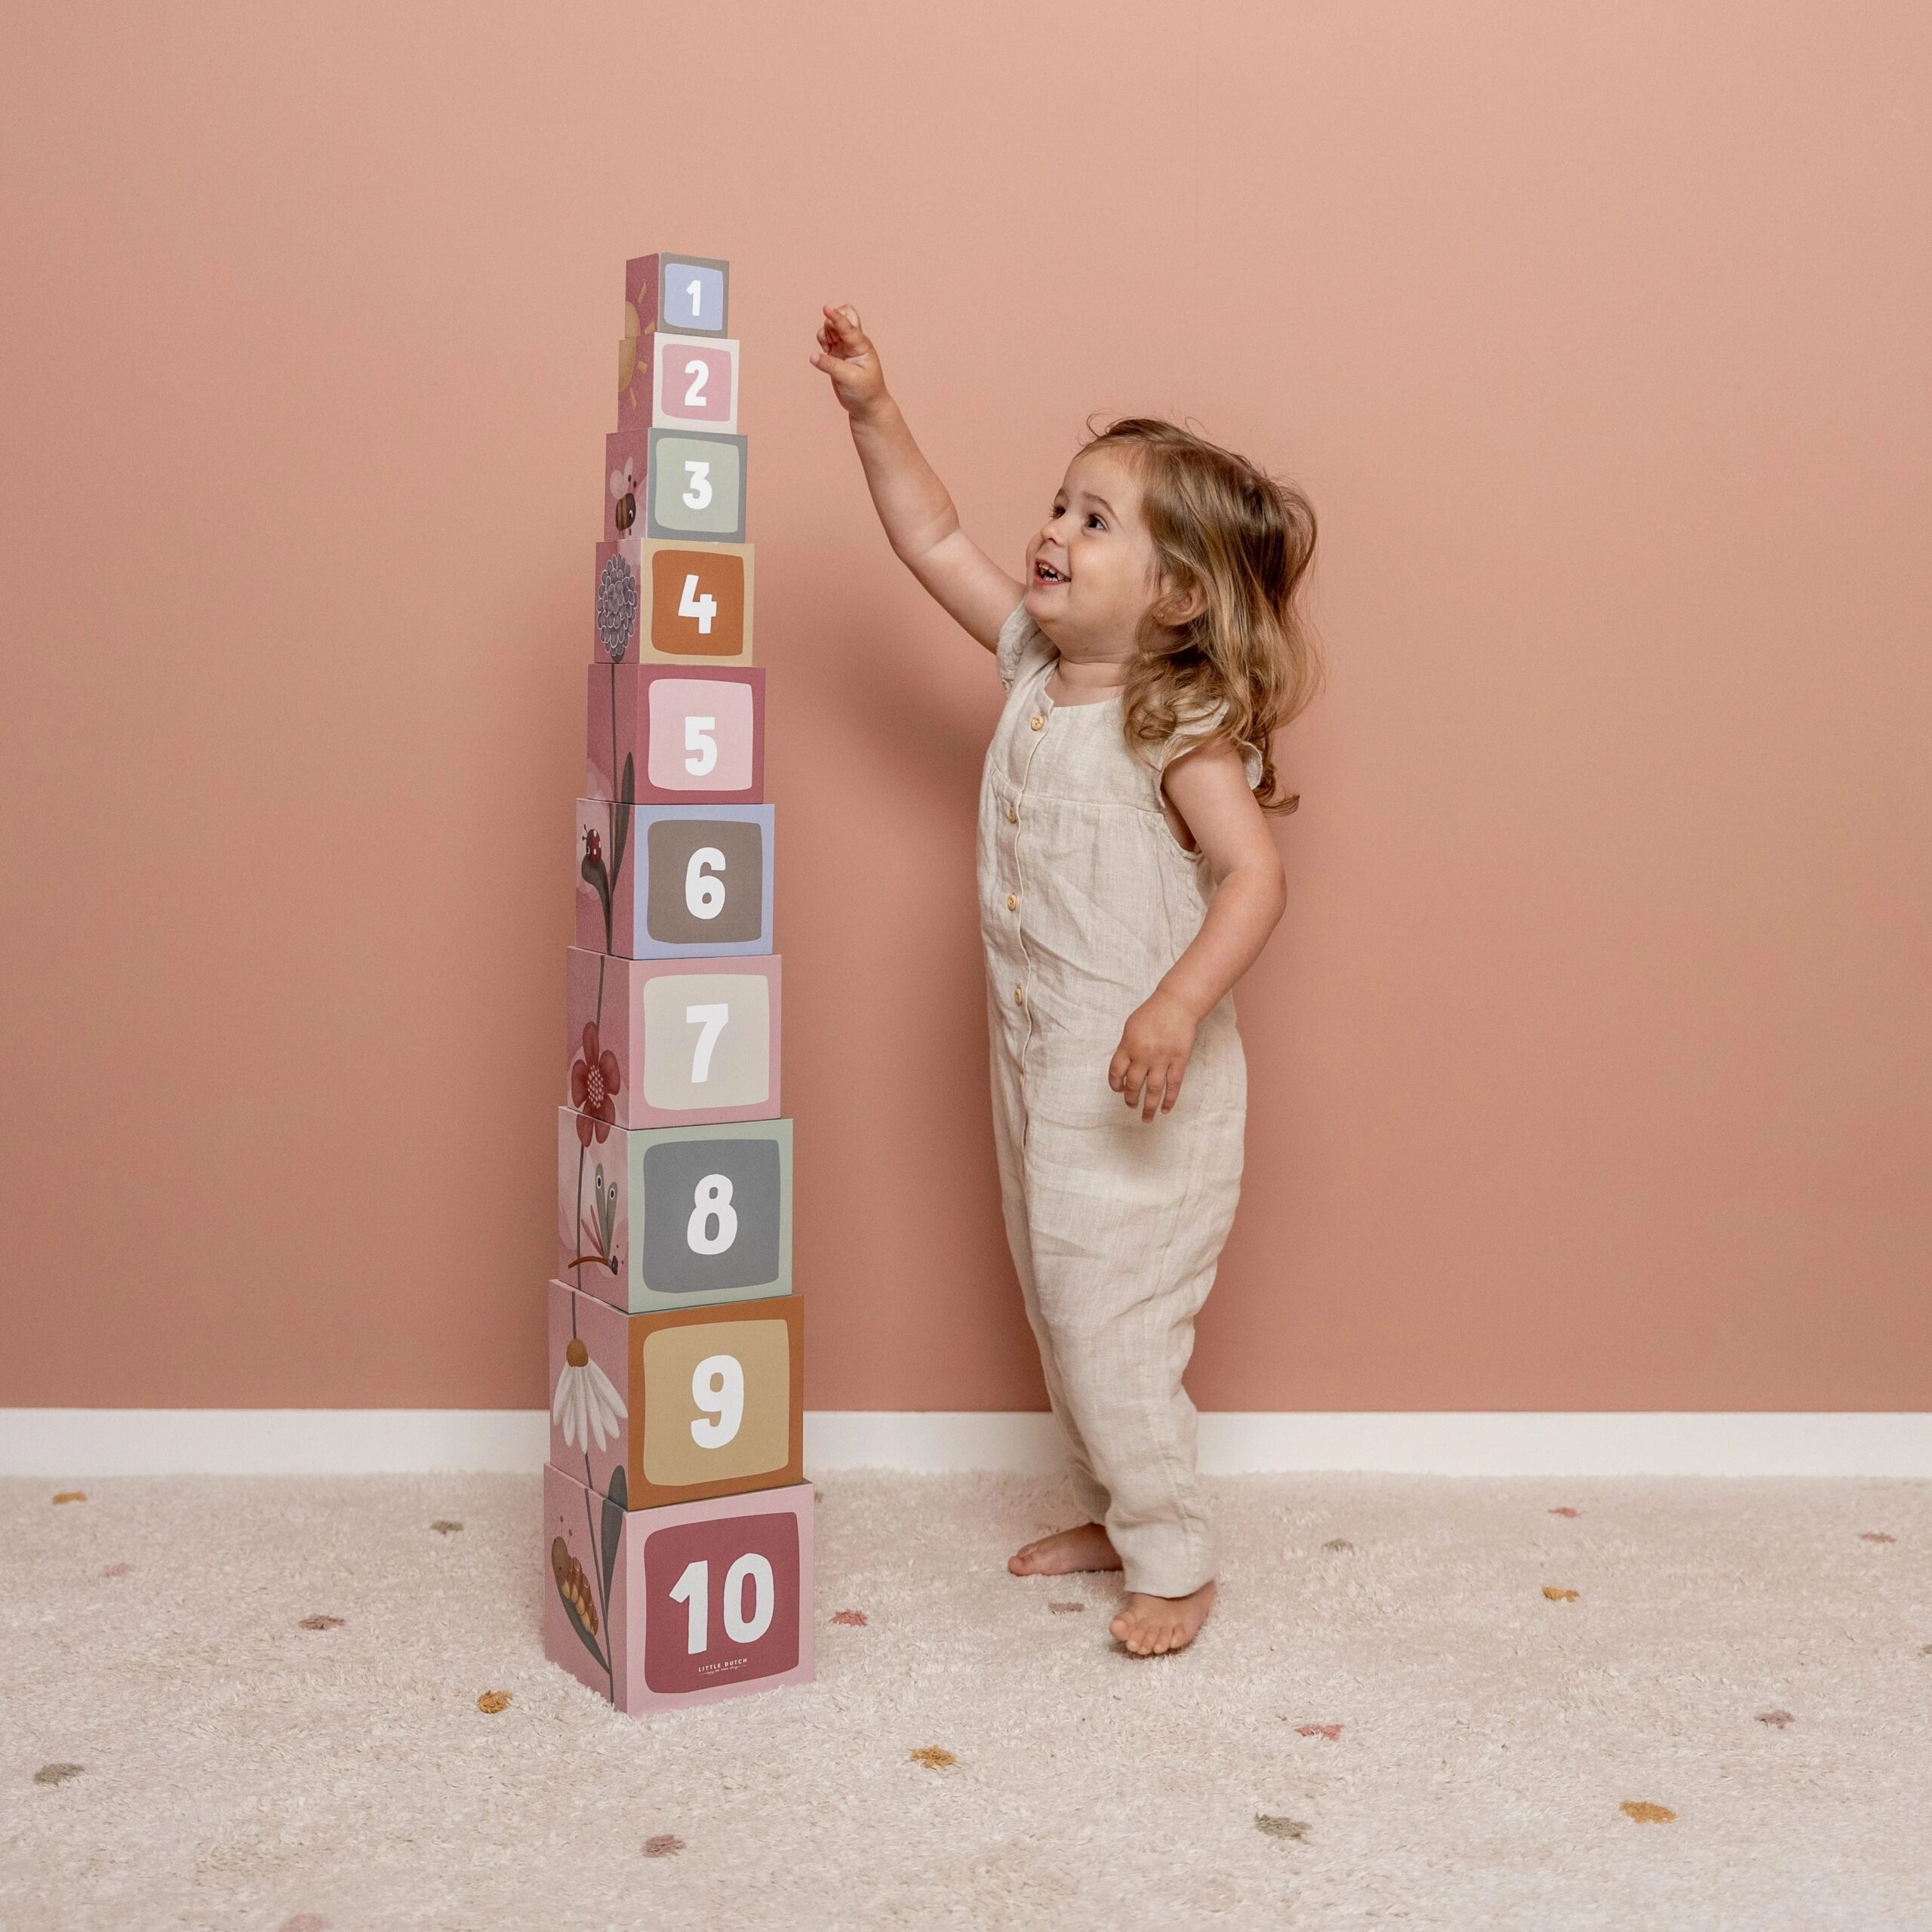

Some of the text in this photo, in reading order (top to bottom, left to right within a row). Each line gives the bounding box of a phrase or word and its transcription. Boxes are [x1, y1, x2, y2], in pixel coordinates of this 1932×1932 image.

[686, 280, 700, 315] 1
[685, 360, 709, 406] 2
[683, 461, 712, 509] 3
[678, 574, 716, 633] 4
[685, 716, 717, 776] 5
[685, 848, 725, 919] 6
[687, 1004, 728, 1083] 7
[688, 1174, 737, 1254] 8
[691, 1355, 744, 1448] 9
[669, 1553, 774, 1654] 10
[698, 1663, 721, 1672] LITTLE
[724, 1657, 748, 1667] DUTCH
